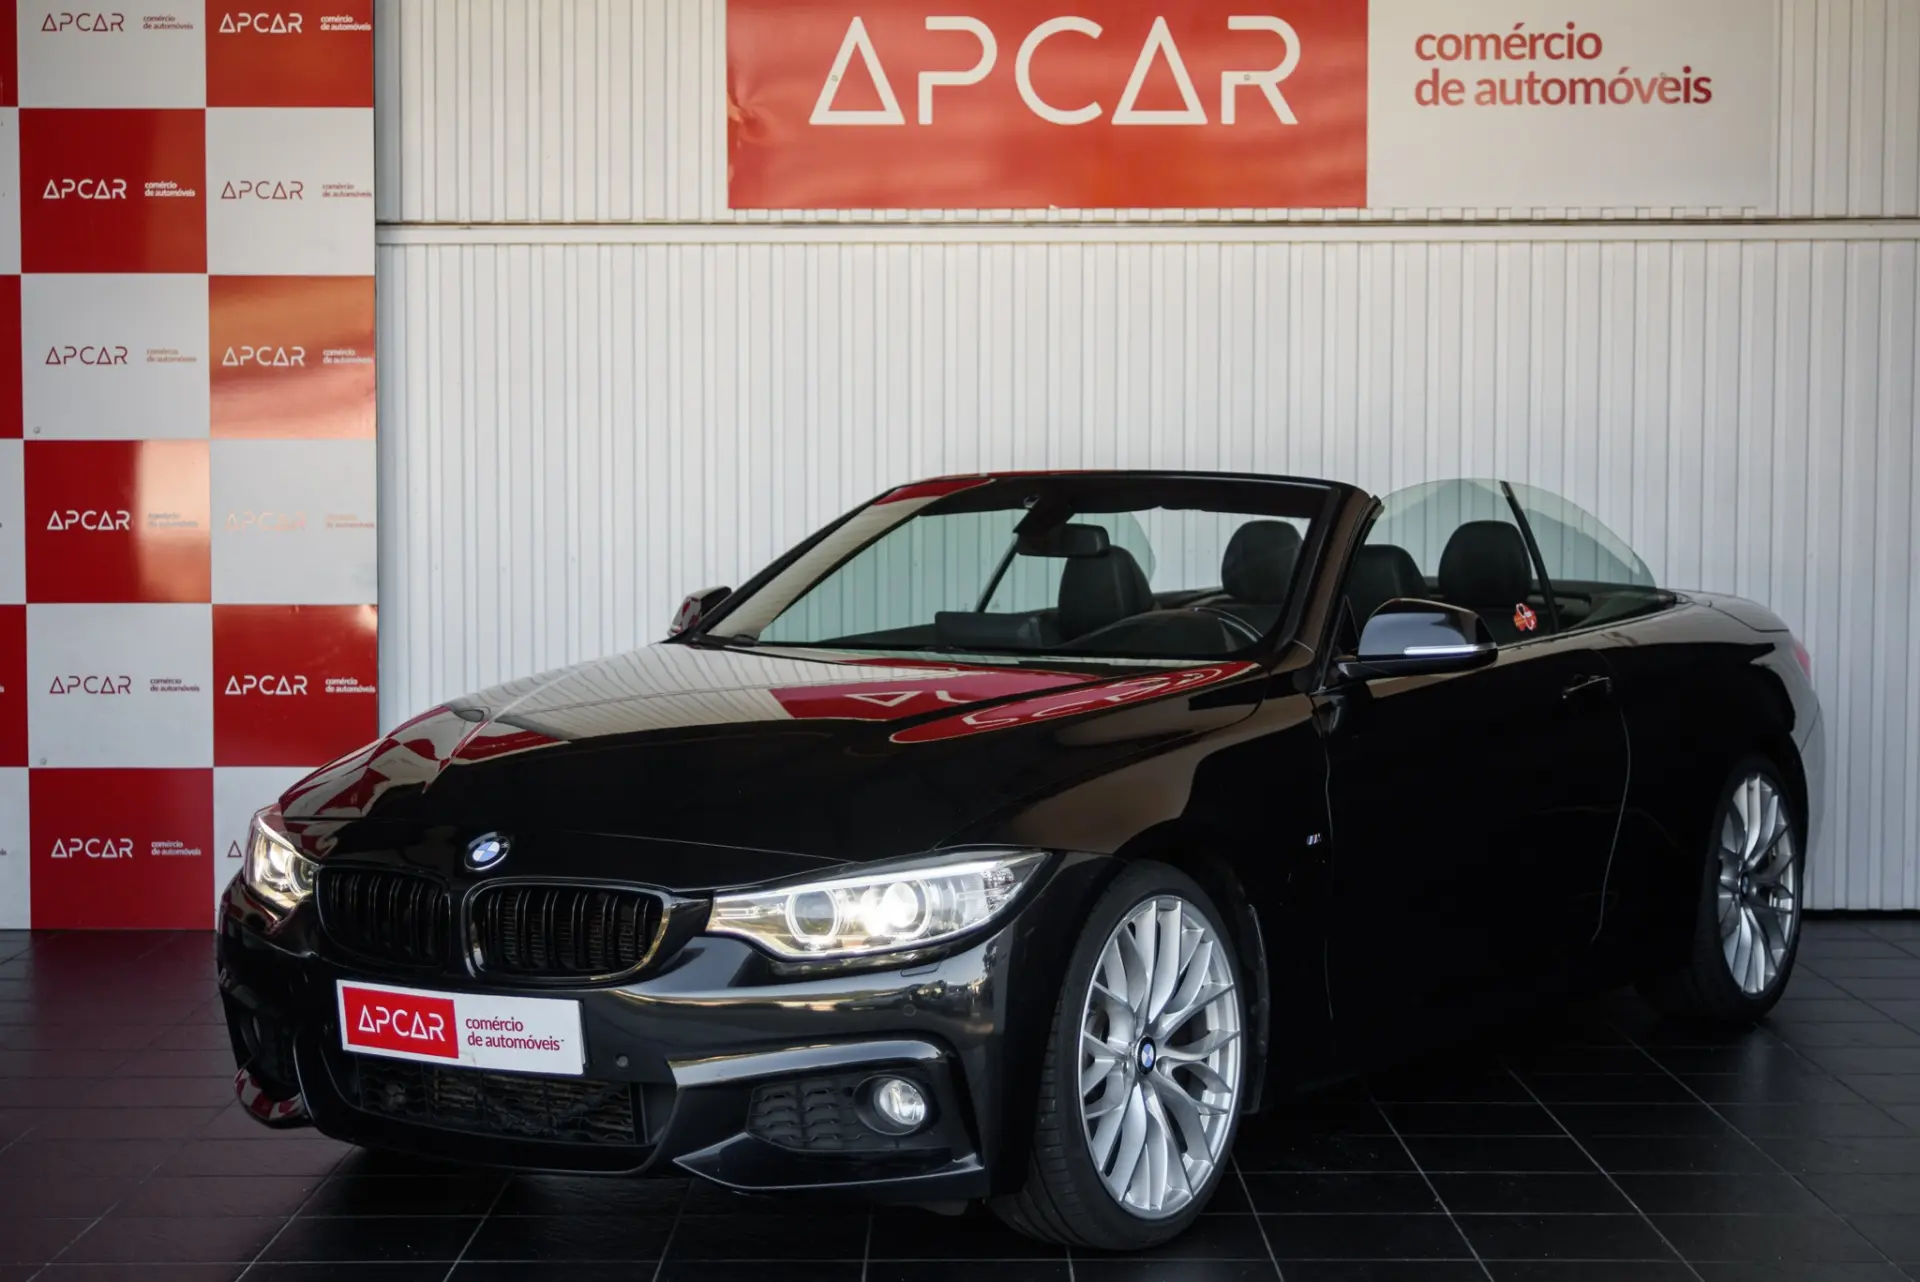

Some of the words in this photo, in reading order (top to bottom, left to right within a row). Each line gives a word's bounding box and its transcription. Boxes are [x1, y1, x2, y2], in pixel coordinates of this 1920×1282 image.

[41, 13, 125, 31] APCAR
[143, 13, 175, 22] comércio
[143, 22, 152, 30] de
[153, 22, 193, 30] automóveis
[219, 12, 303, 33] APCAR
[320, 15, 353, 23] comércio
[320, 23, 330, 31] de
[330, 23, 371, 31] automóveis
[1415, 22, 1602, 61] comércio
[809, 16, 1299, 125] APCAR
[1415, 67, 1464, 107] de
[1475, 67, 1712, 107] automóveis
[43, 179, 127, 199] APCAR
[145, 180, 177, 189] comércio
[145, 189, 154, 197] de
[155, 189, 195, 197] automóveis
[221, 180, 303, 200] APCAR
[45, 346, 128, 365] APCAR
[222, 346, 305, 367] APCAR
[47, 510, 130, 531] APCAR
[49, 675, 132, 695] APCAR
[150, 677, 182, 685] comércio
[225, 675, 308, 695] APCAR
[325, 677, 358, 685] comércio
[325, 685, 335, 693] de
[335, 685, 376, 693] automóveis
[51, 838, 134, 858] APCAR
[151, 840, 183, 848] comércio
[151, 848, 161, 856] de
[161, 848, 201, 856] automóveis
[358, 1004, 446, 1042] APCAR
[465, 1016, 524, 1032] comércio
[467, 1031, 483, 1047] de
[485, 1034, 561, 1051] automóveis
